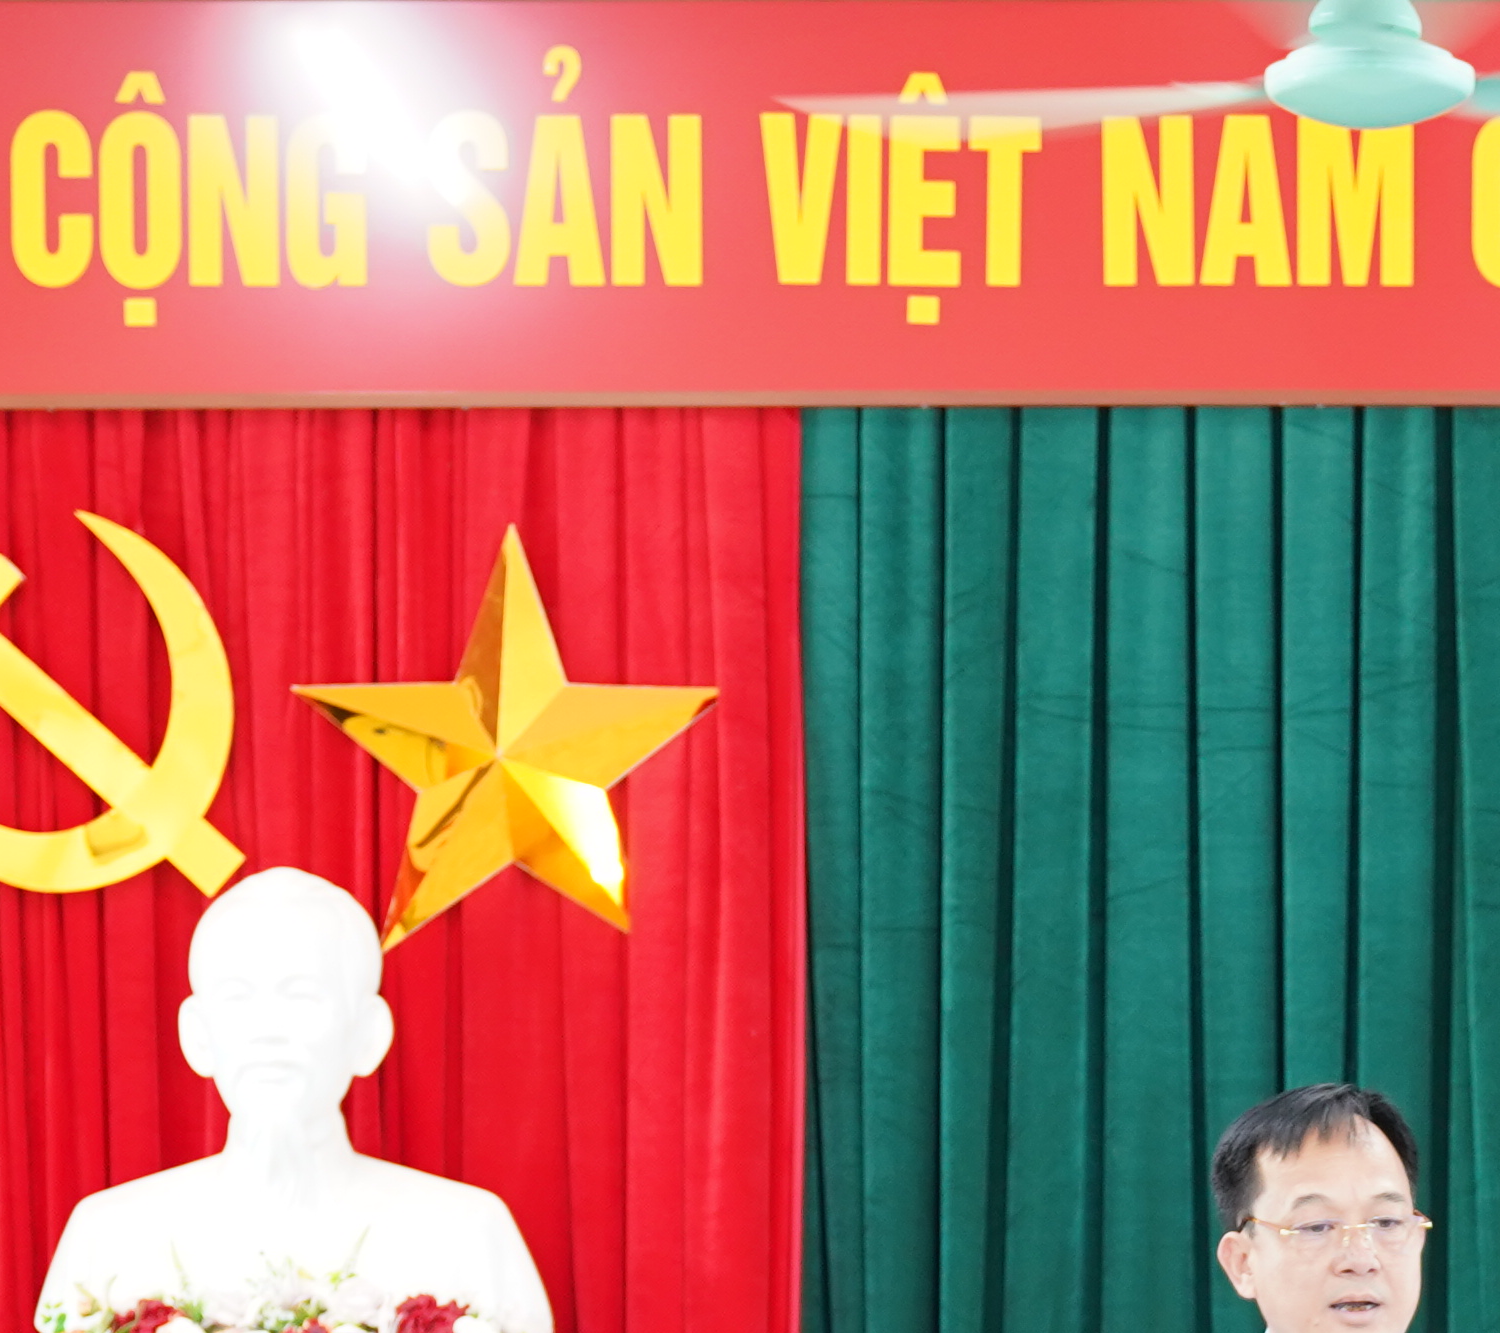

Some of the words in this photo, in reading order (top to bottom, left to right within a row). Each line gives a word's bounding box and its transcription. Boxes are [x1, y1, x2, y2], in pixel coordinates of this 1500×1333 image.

[9, 71, 368, 328] CỘNG
[426, 46, 704, 288] SẢN
[759, 72, 1043, 326] VIỆT
[1100, 113, 1415, 288] NAM
